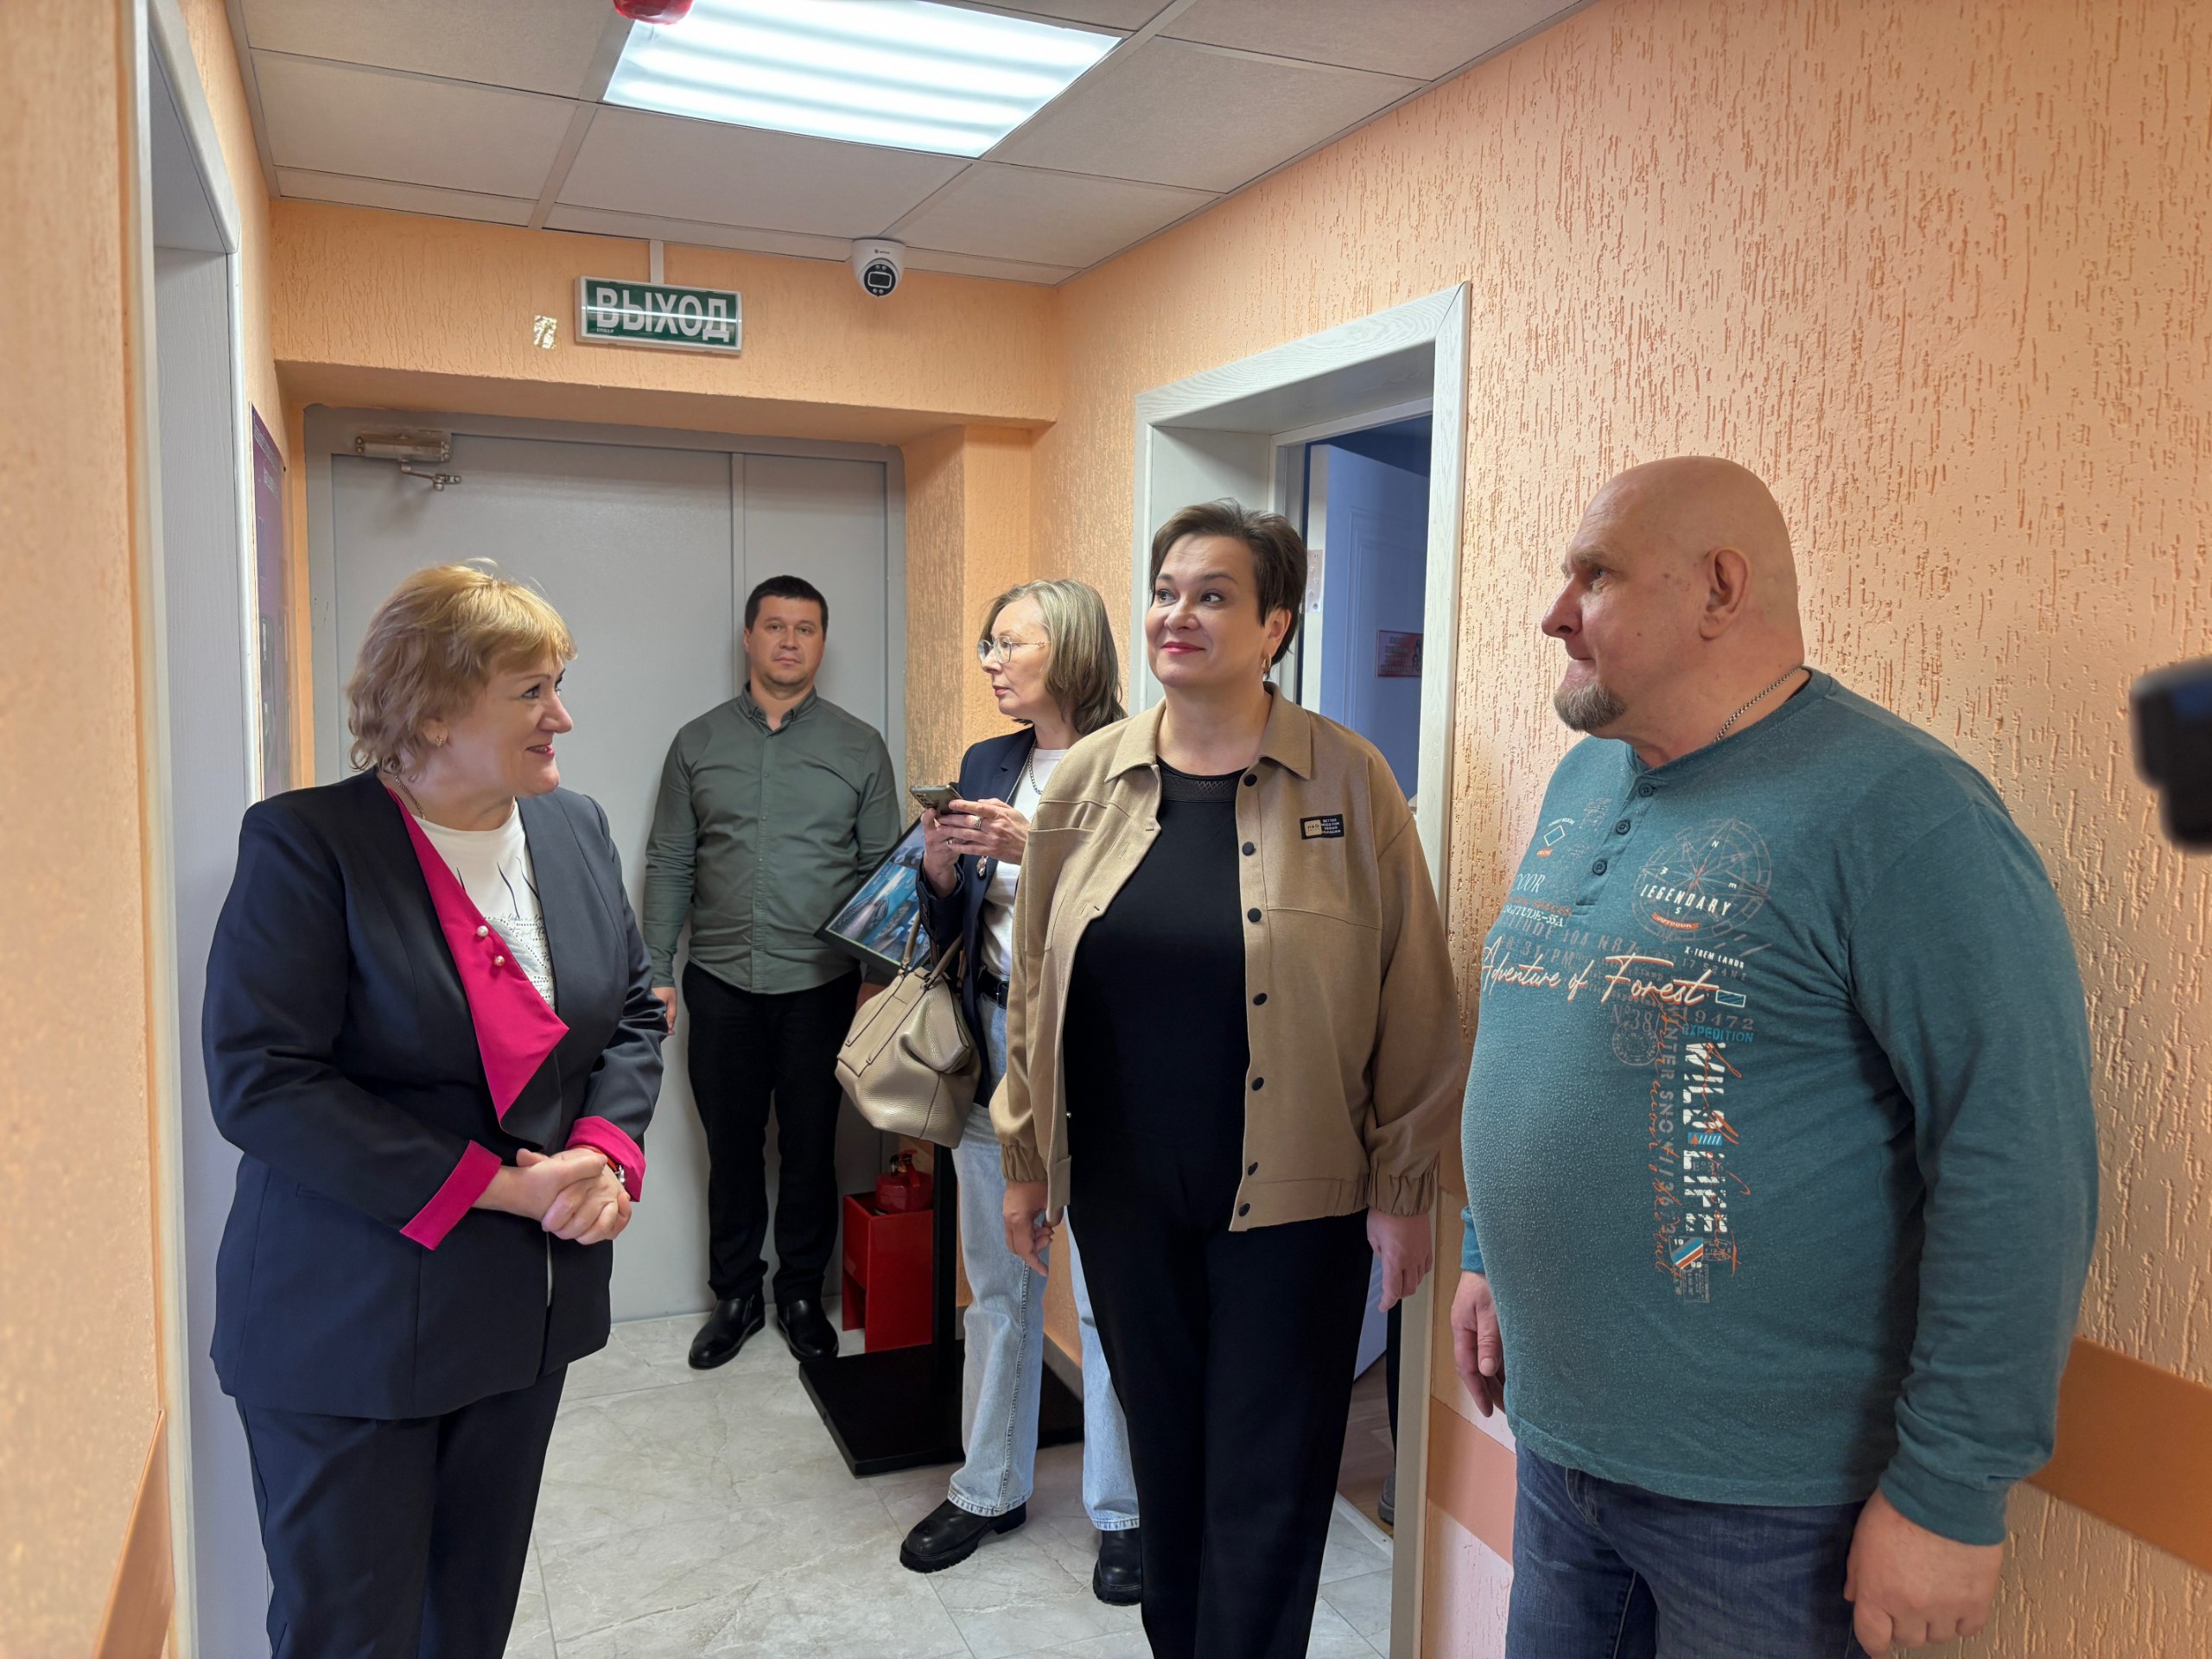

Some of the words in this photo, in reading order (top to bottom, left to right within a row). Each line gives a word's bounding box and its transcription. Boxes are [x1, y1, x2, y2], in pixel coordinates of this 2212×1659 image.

[596, 287, 730, 342] ВЫХОД
[1640, 884, 1732, 917] LEGENDARY
[1481, 936, 1560, 995] Adventure
[1567, 960, 1594, 1002] of
[1601, 952, 1719, 1007] Forest
[1684, 946, 1715, 961] X-TREM
[1718, 955, 1745, 969] LANDS
[1682, 1023, 1754, 1043] EXPEDITION
[1682, 1042, 1726, 1129] WILD
